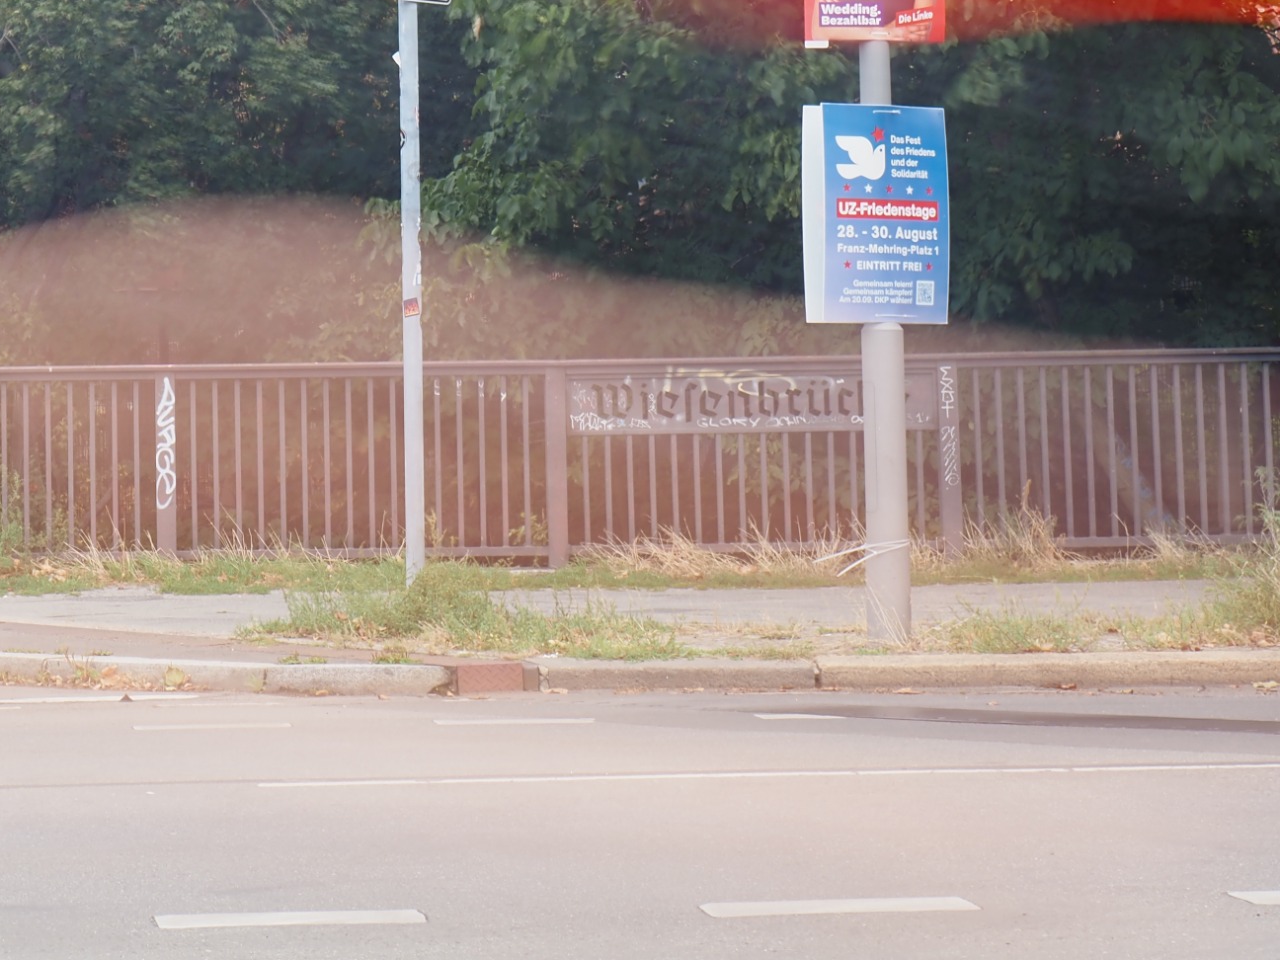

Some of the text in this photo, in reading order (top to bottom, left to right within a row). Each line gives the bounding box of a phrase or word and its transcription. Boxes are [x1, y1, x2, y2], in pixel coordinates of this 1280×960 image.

[820, 3, 882, 17] Wedding.
[821, 16, 882, 26] Bezahlbar
[898, 10, 933, 24] Die Linke
[890, 134, 921, 145] Das Fest
[890, 146, 936, 157] des Friedens
[890, 158, 918, 167] und der
[891, 168, 928, 179] Solidarität
[838, 201, 937, 221] UZ-Friedenstage
[837, 225, 858, 238] 28.
[871, 225, 892, 239] 30.
[895, 226, 938, 243] August
[837, 243, 939, 256] Franz-Mehring-Platz 1
[856, 260, 922, 272] EINTRITT FREI
[853, 279, 894, 288] Gemeinsam
[843, 287, 885, 295] Gemeinsam
[874, 296, 889, 304] DKP
[591, 379, 910, 423] Wiesenbrüc
